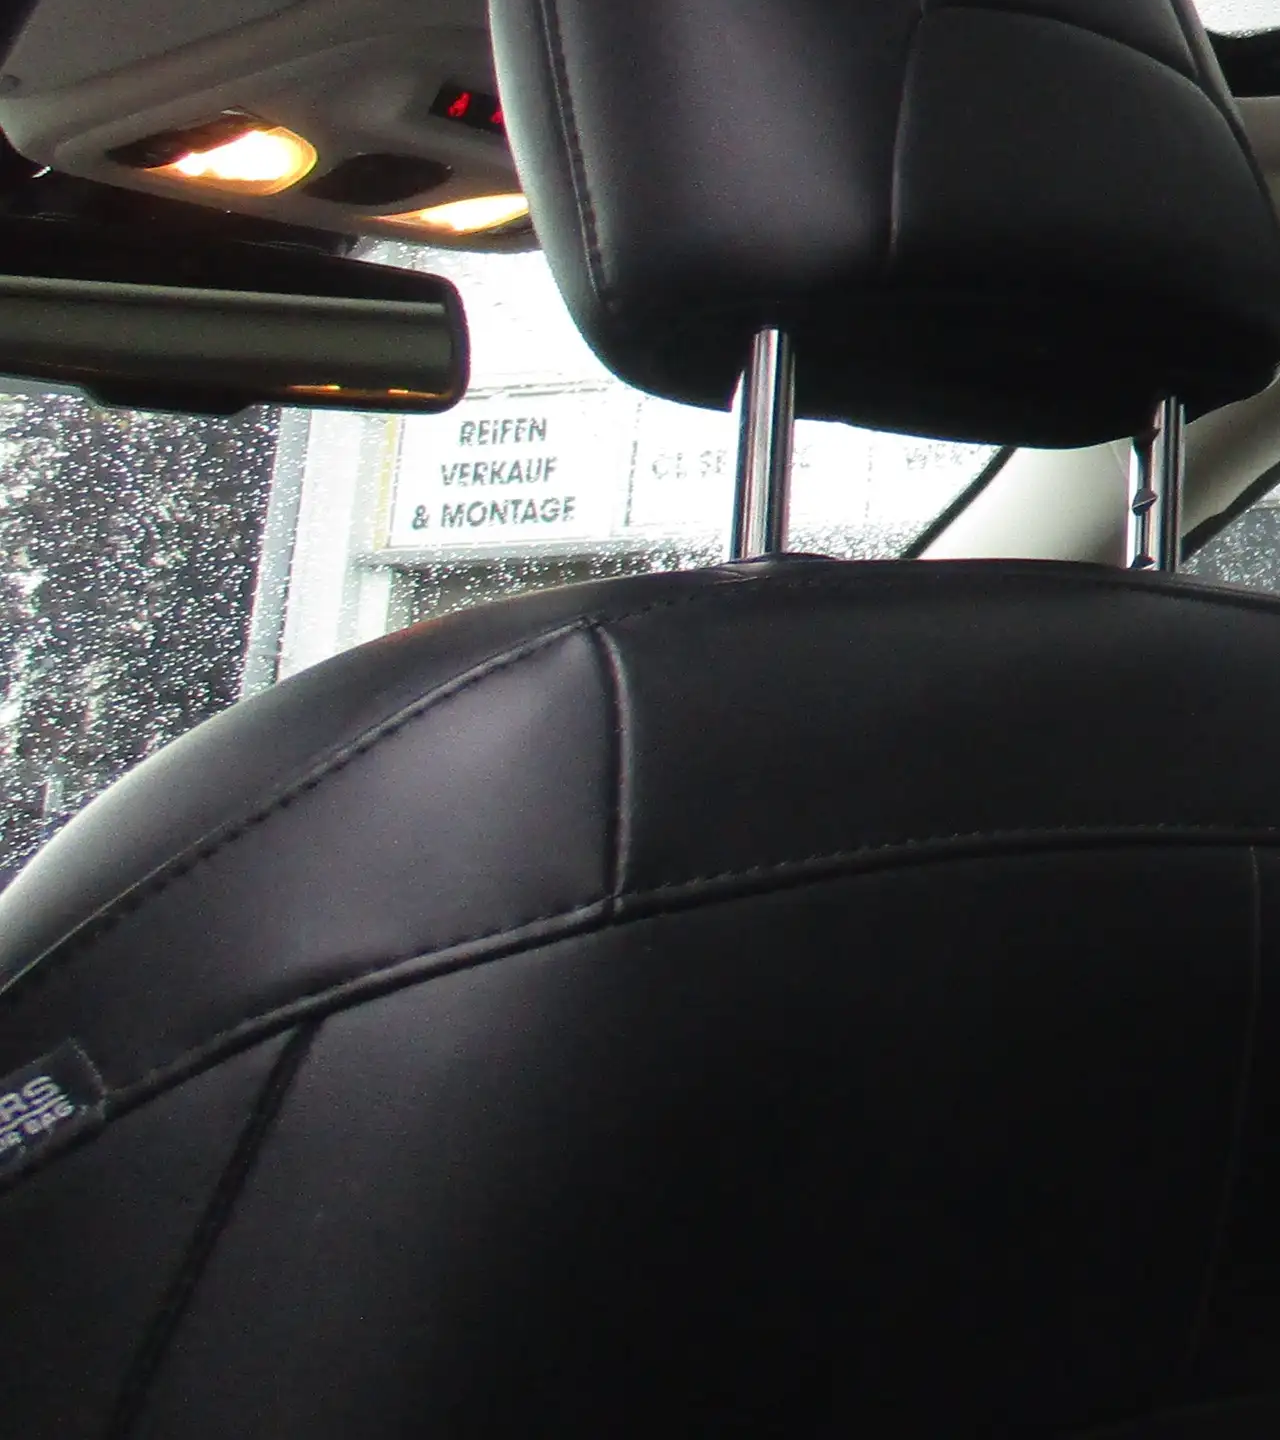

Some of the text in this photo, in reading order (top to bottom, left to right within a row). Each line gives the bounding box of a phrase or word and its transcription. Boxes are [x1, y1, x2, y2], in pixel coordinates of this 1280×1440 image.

[441, 456, 557, 488] VERKAUF
[412, 496, 576, 530] & MONTAGE
